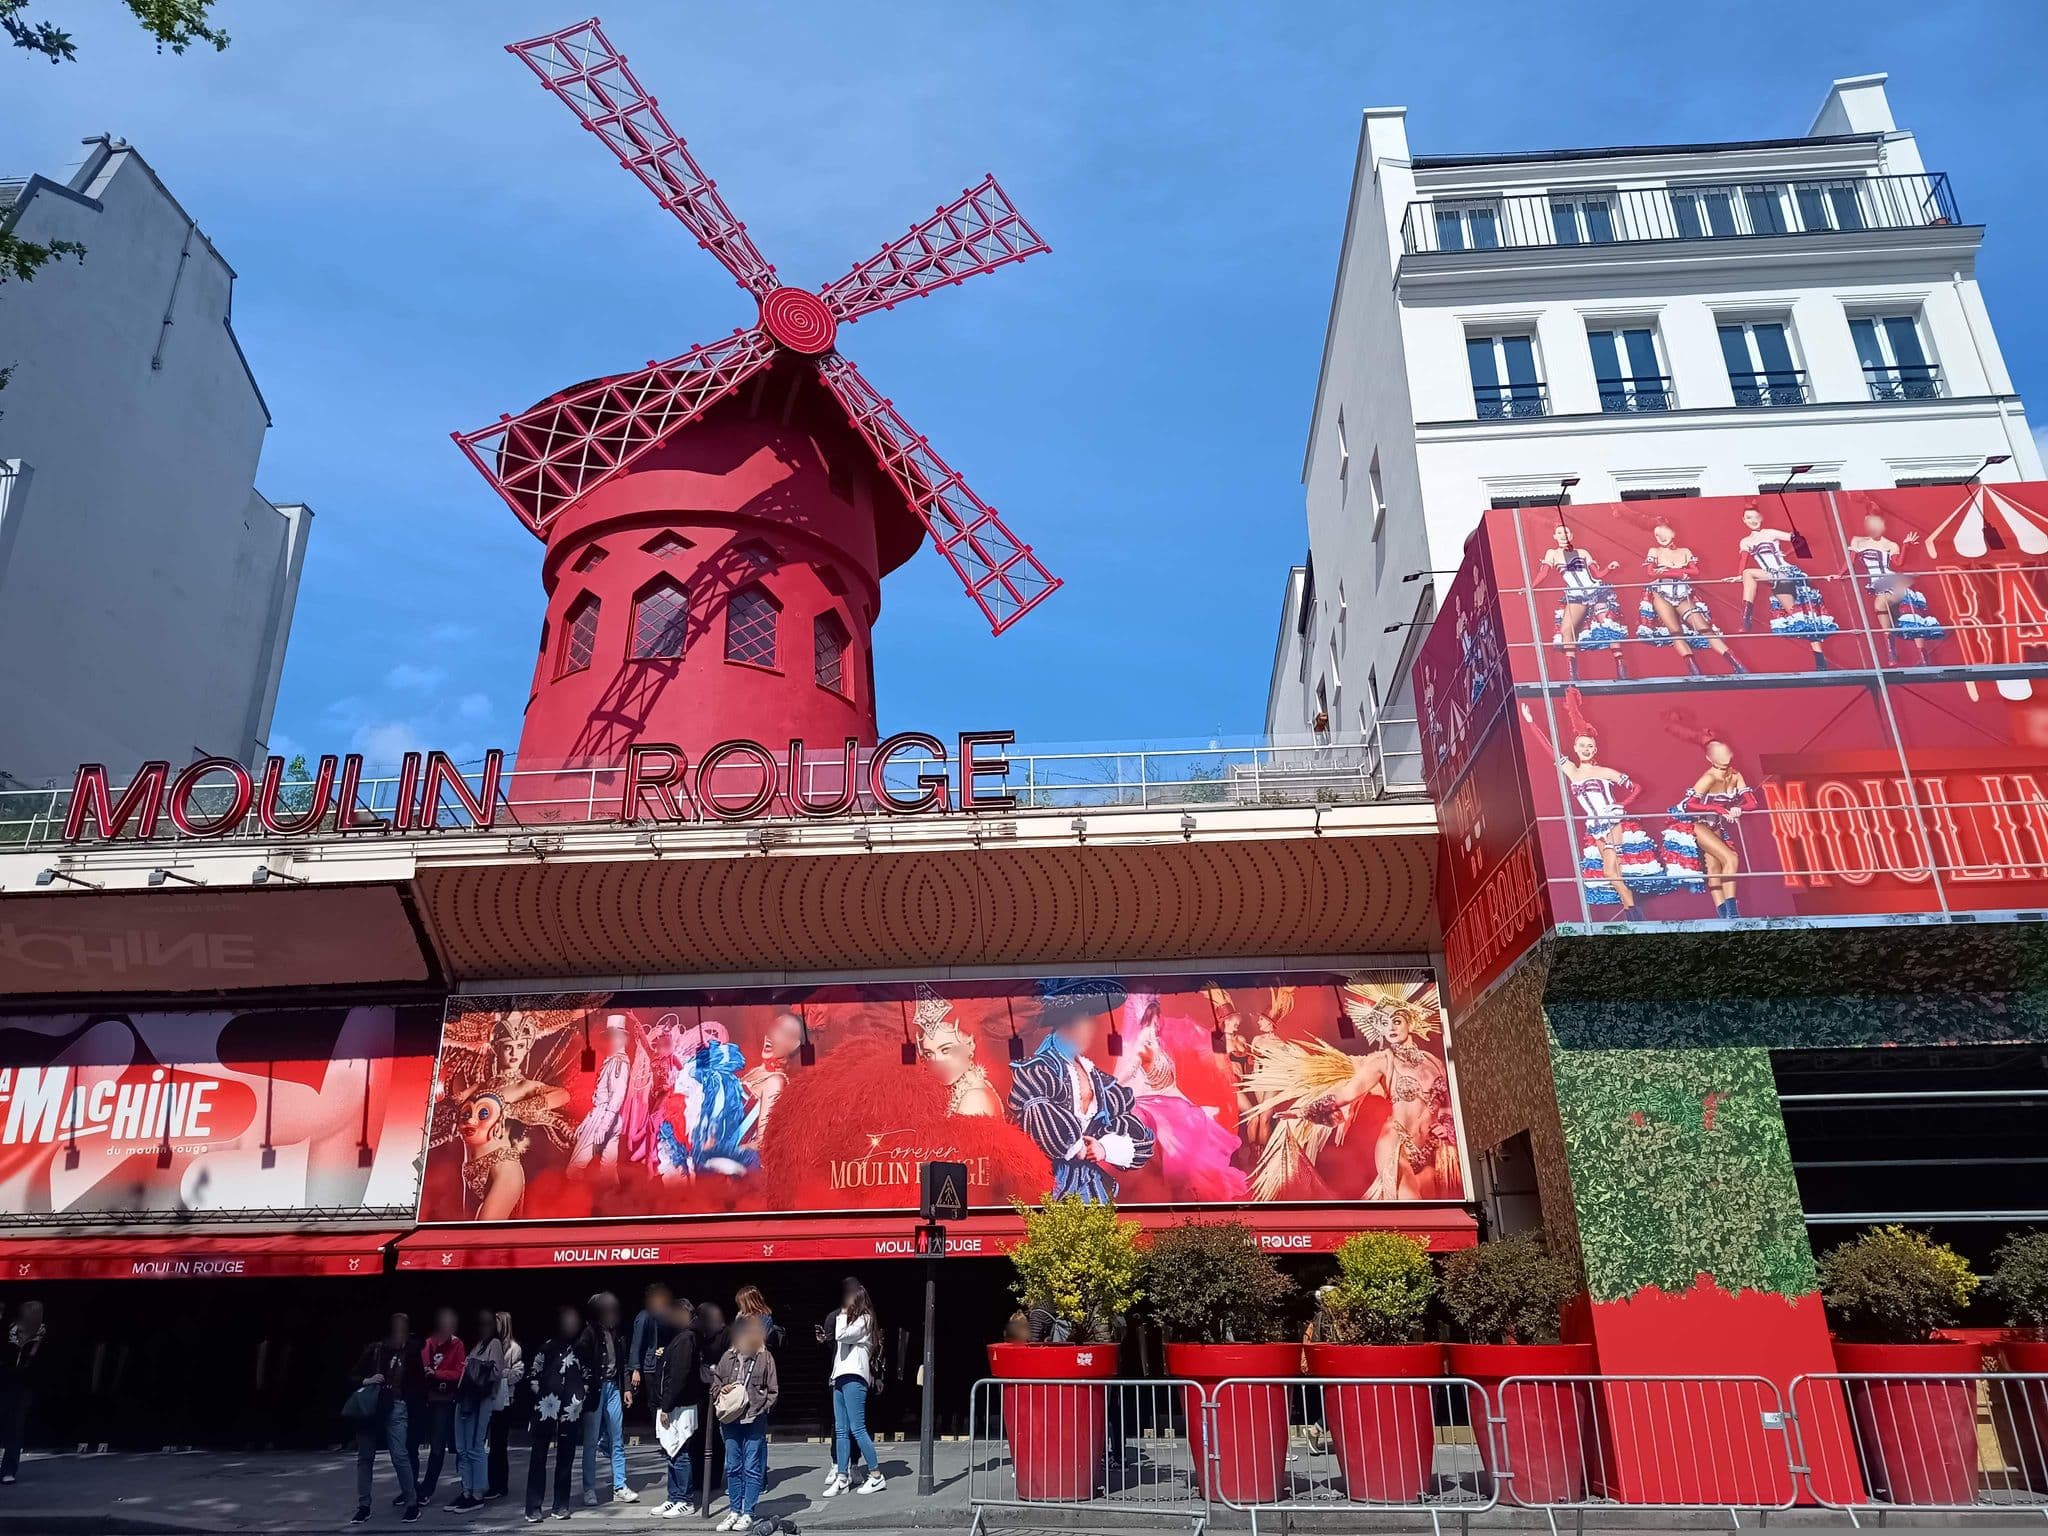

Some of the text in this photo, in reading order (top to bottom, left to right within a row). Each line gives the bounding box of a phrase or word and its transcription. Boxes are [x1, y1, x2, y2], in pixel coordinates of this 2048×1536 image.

[64, 730, 1015, 843] MOULIN ROUGE
[106, 1145, 121, 1155] du
[126, 1145, 167, 1155] moulin
[854, 1129, 959, 1169] Forever
[830, 1160, 909, 1190] MOULIN
[875, 1240, 981, 1253] MOUL OUGE
[1261, 1236, 1312, 1248] ROUGE
[554, 1248, 659, 1262] MOULIN ROUGE
[132, 1261, 245, 1274] MOULIN ROUGE
